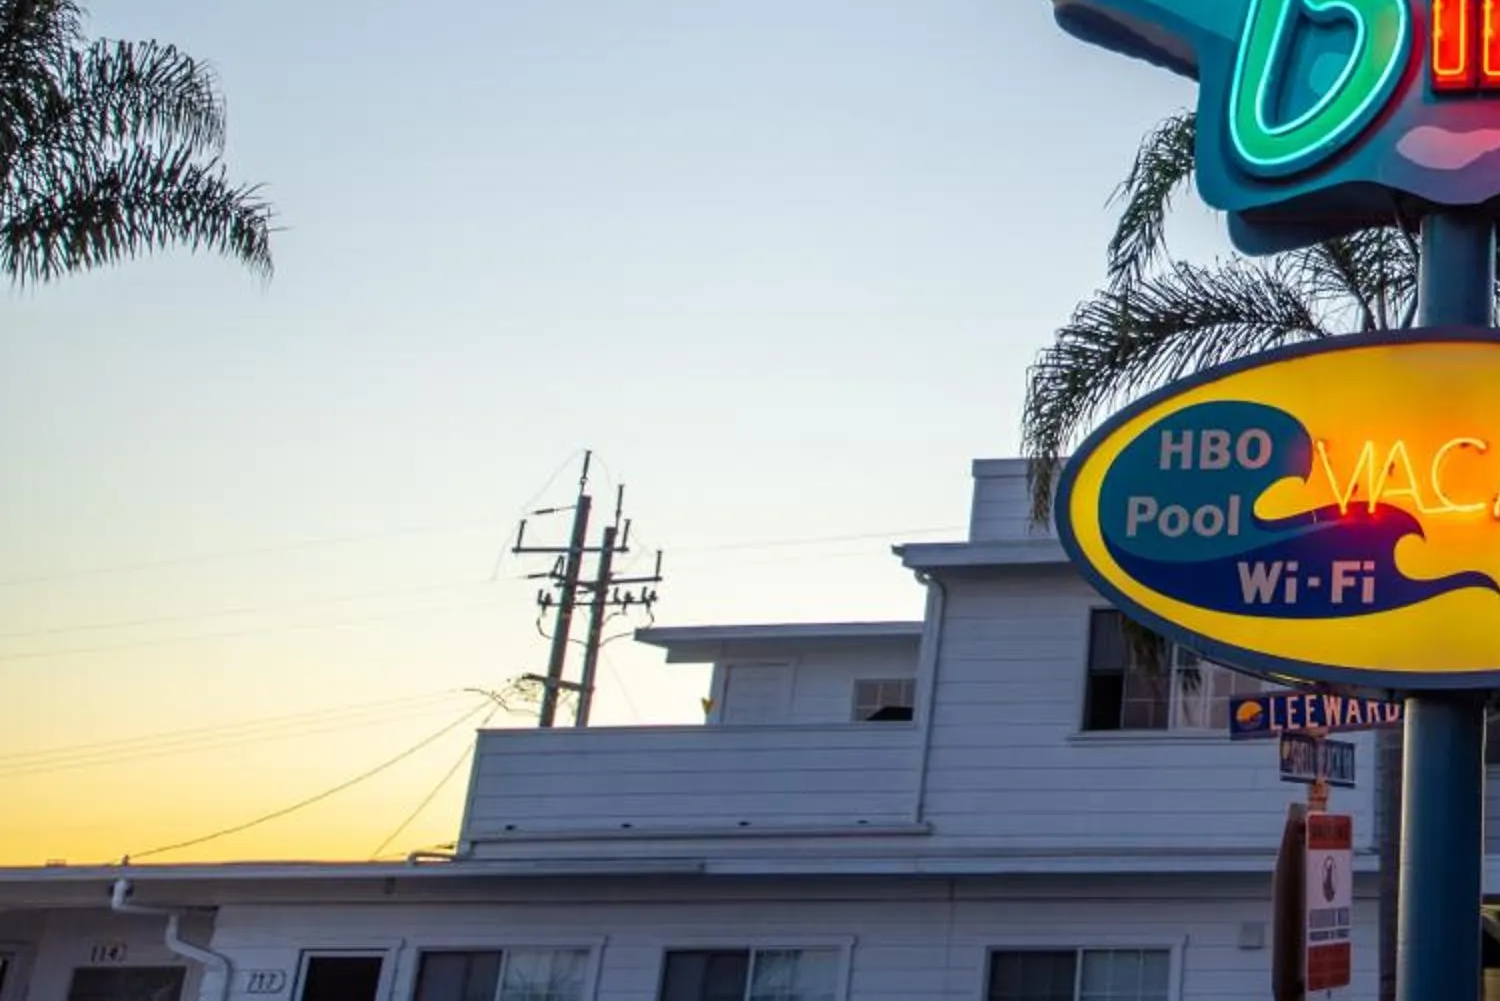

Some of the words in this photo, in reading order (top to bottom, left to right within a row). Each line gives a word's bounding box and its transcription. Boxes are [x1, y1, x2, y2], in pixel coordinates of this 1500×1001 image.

[1159, 428, 1272, 471] HBO
[1125, 496, 1241, 539] Pool
[1237, 559, 1376, 604] Wi-Fi
[1269, 695, 1400, 730] LEEWARD
